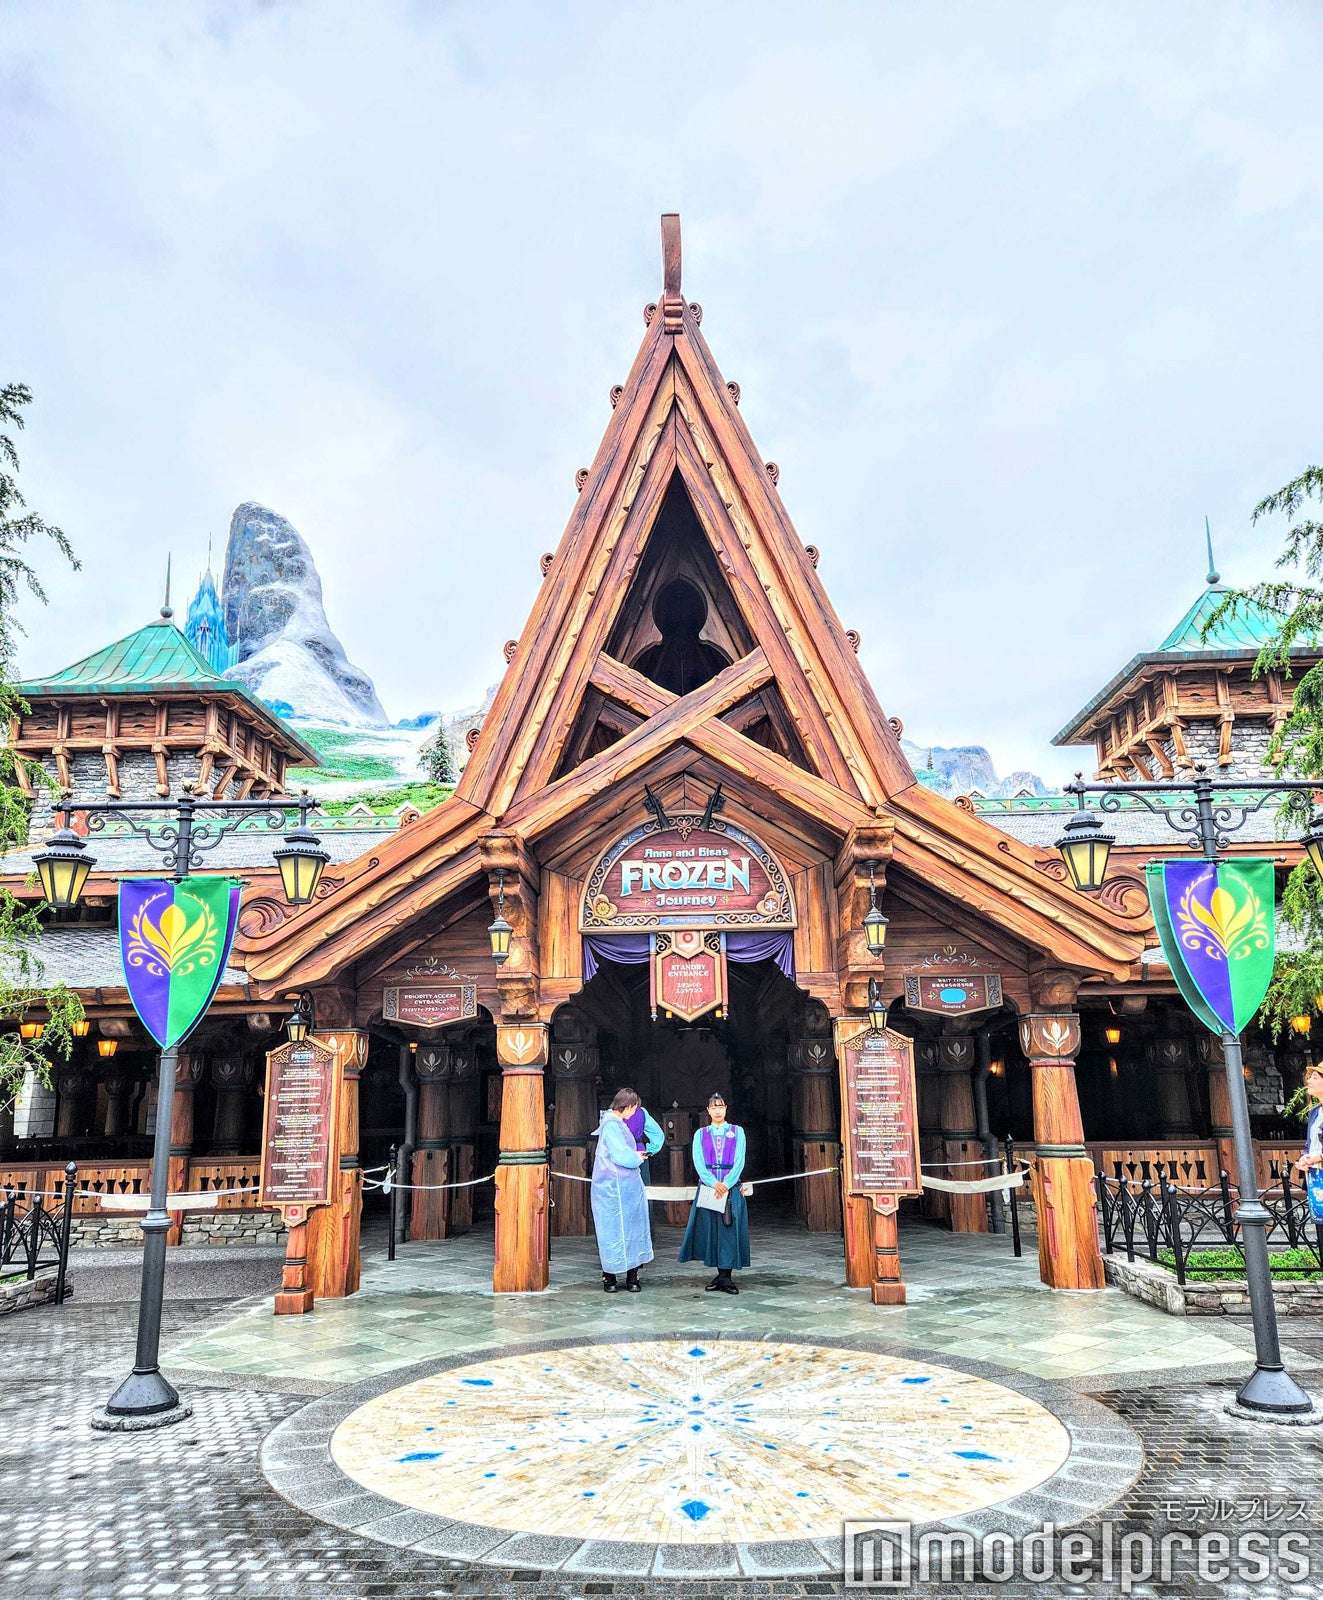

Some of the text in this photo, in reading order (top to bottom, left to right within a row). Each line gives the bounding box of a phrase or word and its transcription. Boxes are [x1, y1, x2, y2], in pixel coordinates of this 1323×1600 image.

[644, 847, 729, 858] Anna and Elsa's
[620, 857, 752, 897] FROZEN
[656, 894, 718, 908] Journey
